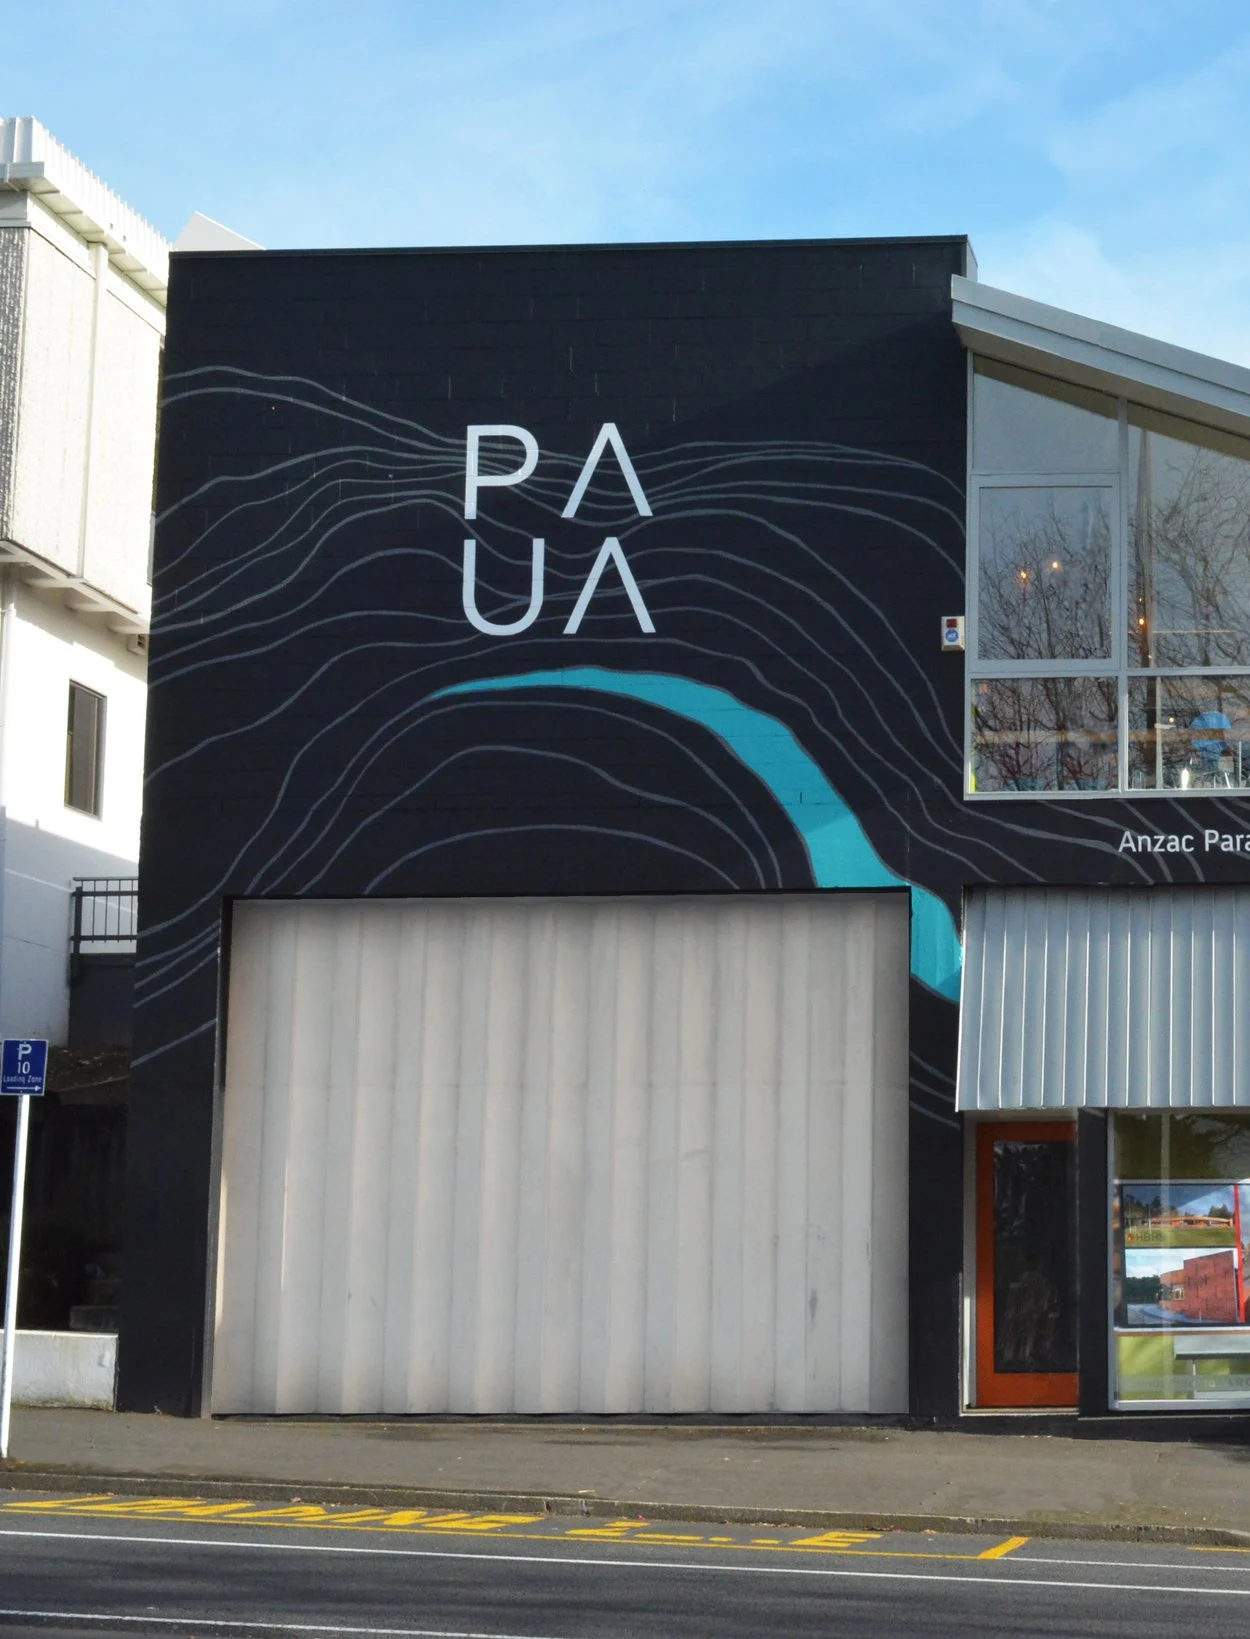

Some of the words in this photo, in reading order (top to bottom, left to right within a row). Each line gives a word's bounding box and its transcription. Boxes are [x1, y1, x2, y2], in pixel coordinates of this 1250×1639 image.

[464, 422, 653, 519] PA
[462, 536, 656, 636] UA
[1118, 831, 1194, 852] Anzac
[18, 1043, 32, 1060] P
[18, 1061, 30, 1074] 10
[565, 1520, 884, 1547] ZE
